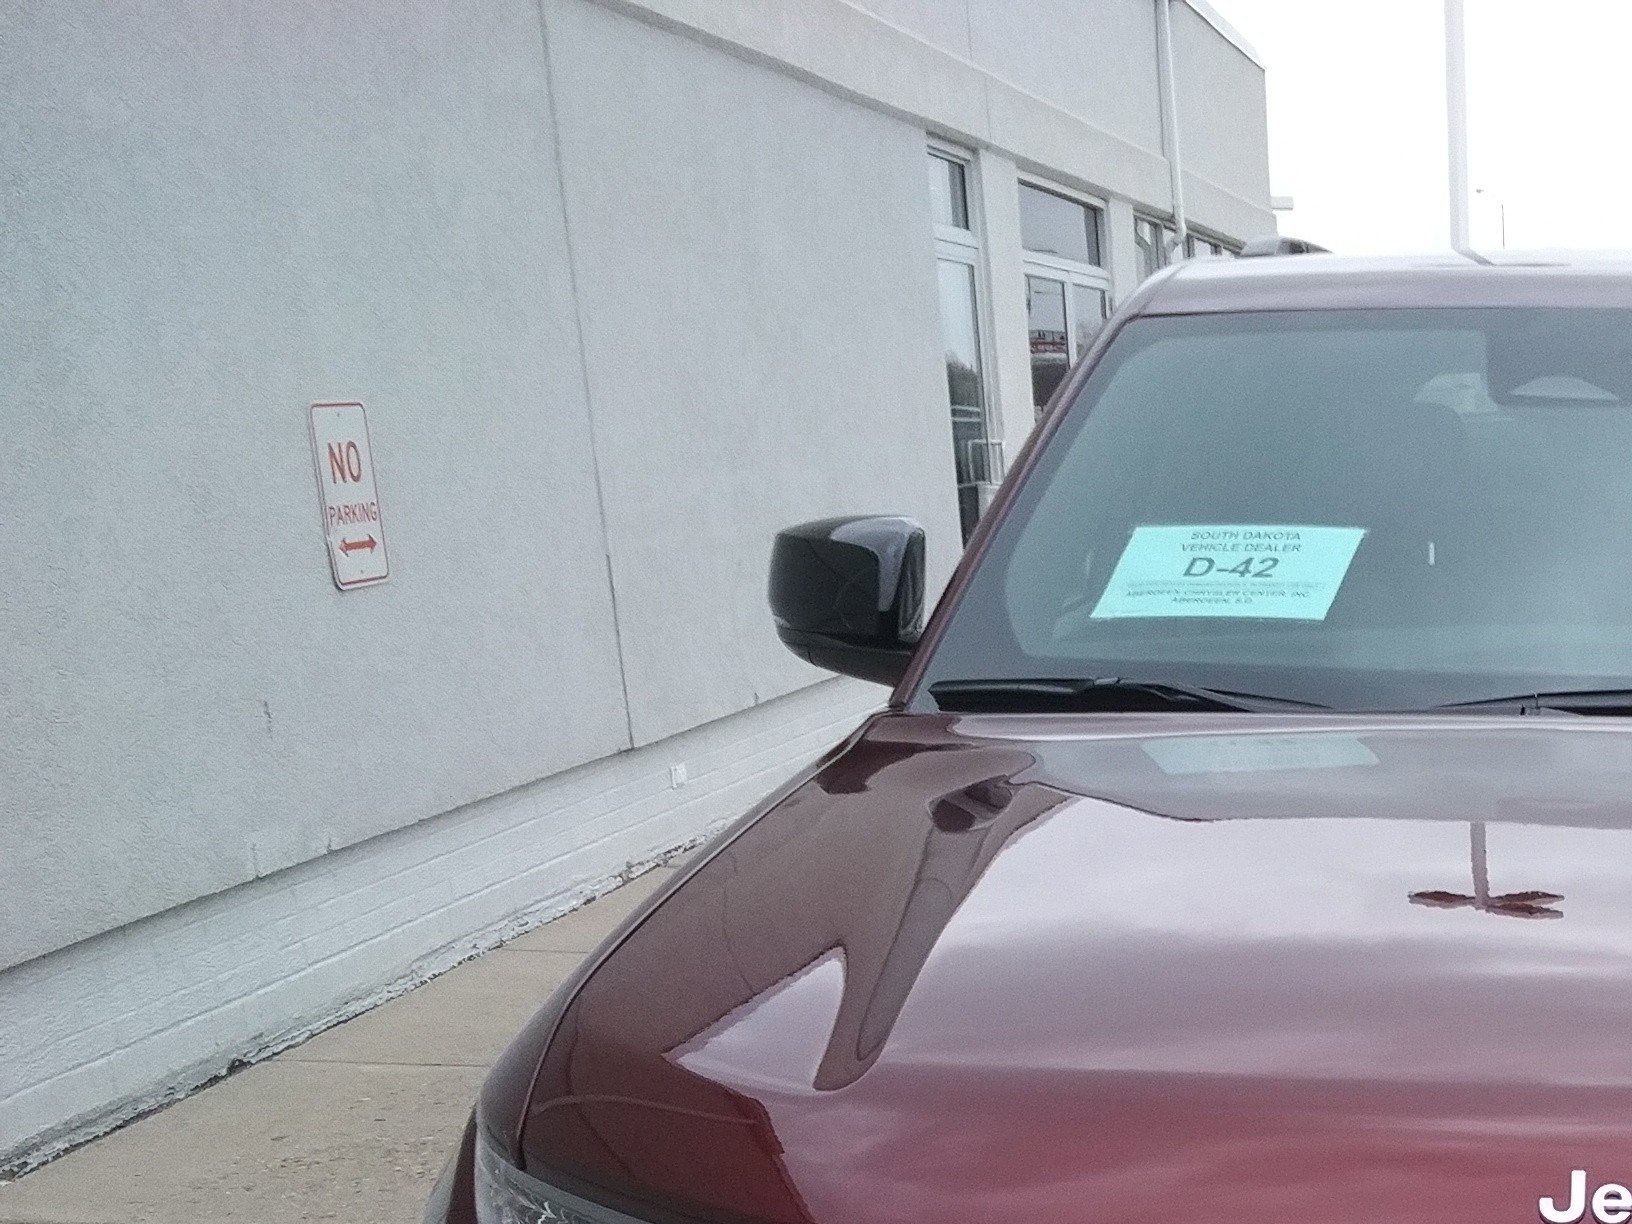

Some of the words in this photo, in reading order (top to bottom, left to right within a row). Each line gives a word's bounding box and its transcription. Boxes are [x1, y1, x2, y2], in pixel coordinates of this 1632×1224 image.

[327, 440, 362, 485] NO
[328, 502, 378, 526] PARKING
[1191, 531, 1239, 540] SOUTH
[1243, 531, 1301, 541] DAKOTA
[1181, 543, 1240, 552] VEHICLE
[1244, 543, 1302, 552] DEALER
[1182, 557, 1280, 578] D-42
